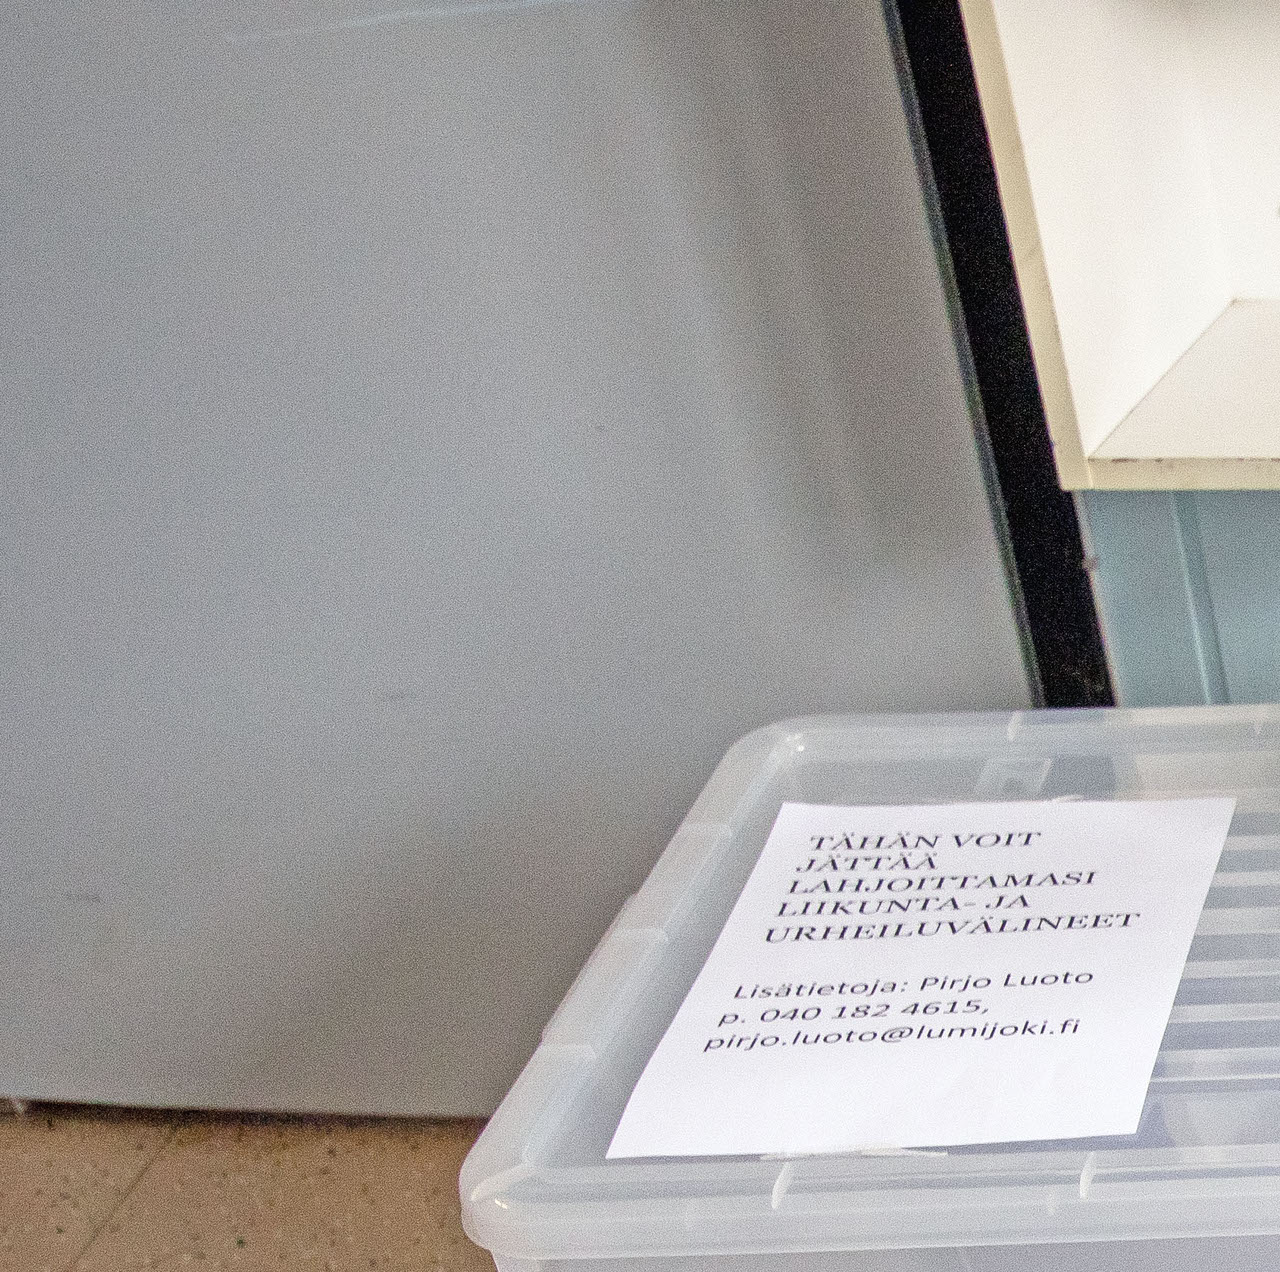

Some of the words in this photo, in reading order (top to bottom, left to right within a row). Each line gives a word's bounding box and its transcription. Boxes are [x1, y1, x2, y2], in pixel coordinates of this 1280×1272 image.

[810, 831, 941, 850] TÄHÄN
[953, 831, 1041, 848] VOIT
[796, 852, 938, 872] JÄTTÄÄ
[788, 871, 1097, 894] LAHJOITTAMASI
[776, 896, 976, 917] LIIKUNTA-
[985, 895, 1030, 909] JA
[765, 913, 1140, 943] URHEILUVÄLINEET
[734, 979, 908, 999] Lisätietoja:
[920, 975, 992, 993] Pirjo
[1003, 971, 1094, 987] Luoto
[718, 1013, 746, 1027] p.
[760, 1006, 821, 1022] 040
[831, 1003, 890, 1019] 182
[900, 999, 989, 1016] 4615,
[703, 1018, 1081, 1052] pirjo.luoto@lumijoki.fi
